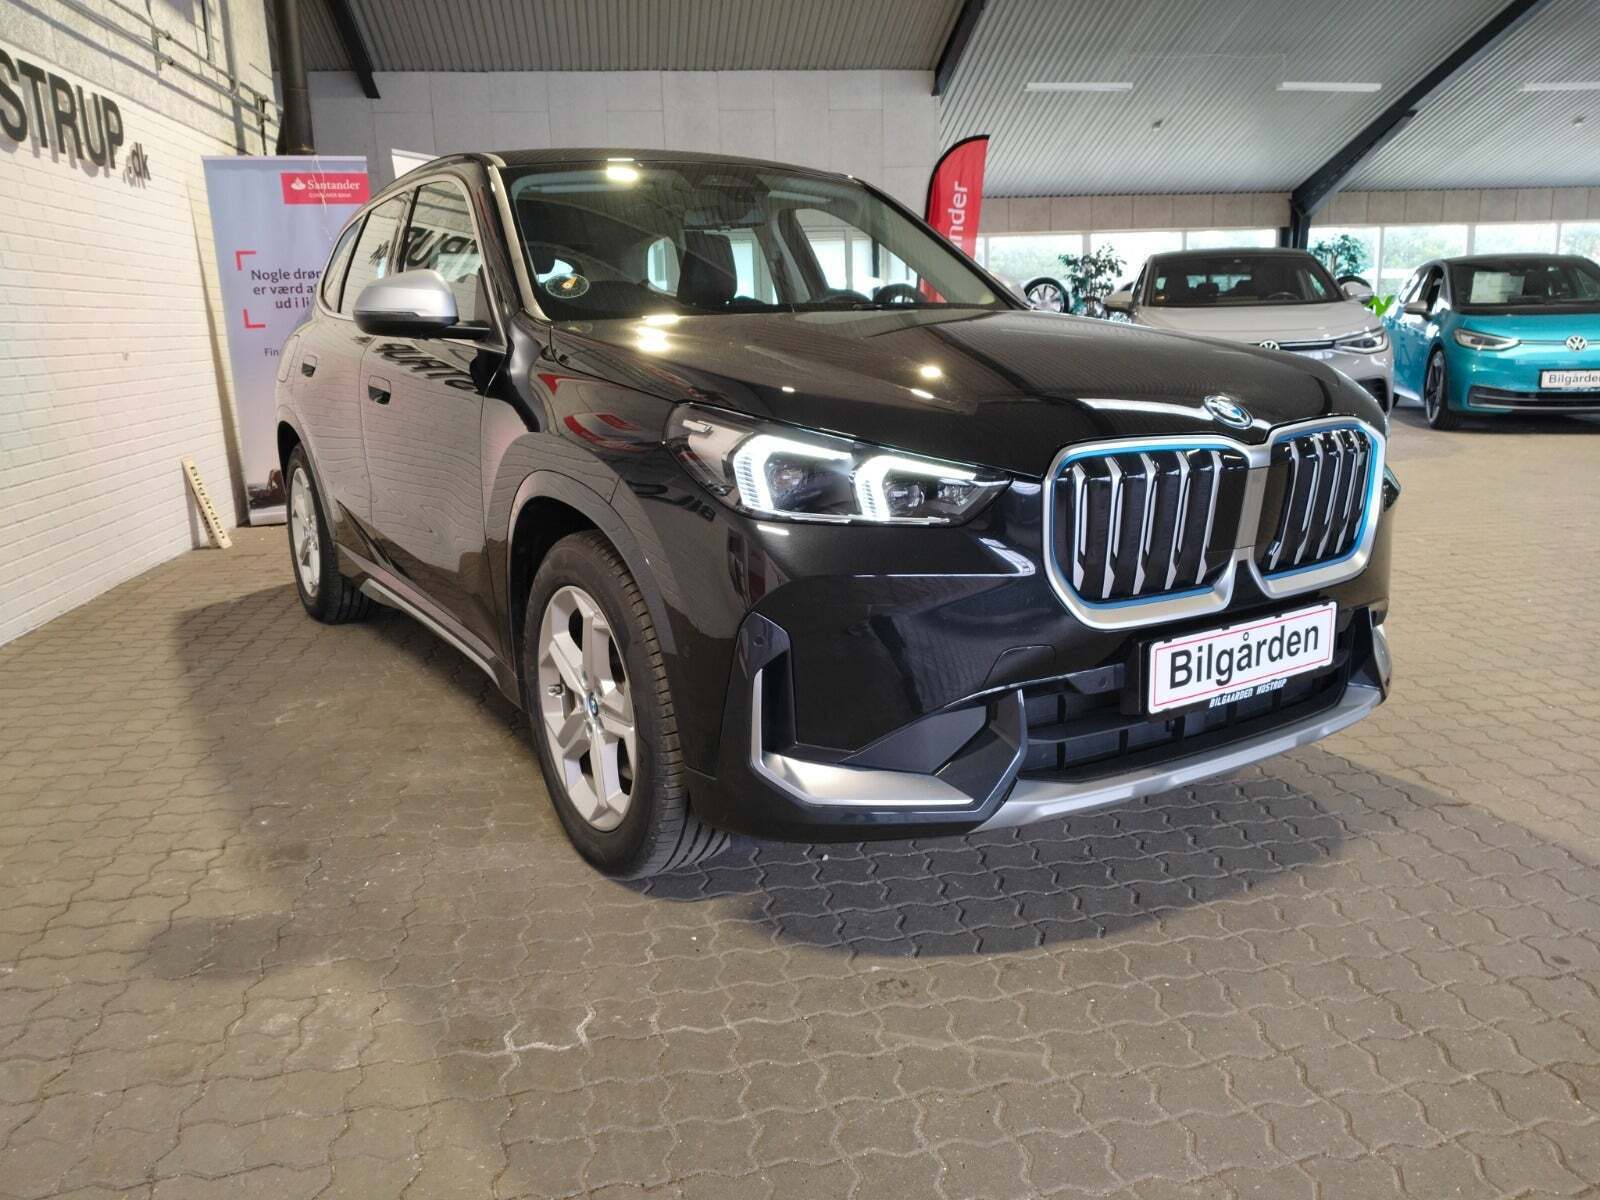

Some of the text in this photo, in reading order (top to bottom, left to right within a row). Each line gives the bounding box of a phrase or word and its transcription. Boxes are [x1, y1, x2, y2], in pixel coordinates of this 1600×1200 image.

[307, 179, 360, 190] Santander
[251, 269, 290, 283] Nogle
[253, 286, 266, 295] er
[270, 283, 303, 295] værd
[275, 298, 292, 309] ud
[295, 297, 299, 308] i
[1549, 374, 1600, 385] Bilgårde
[1169, 624, 1319, 690] Bilgården
